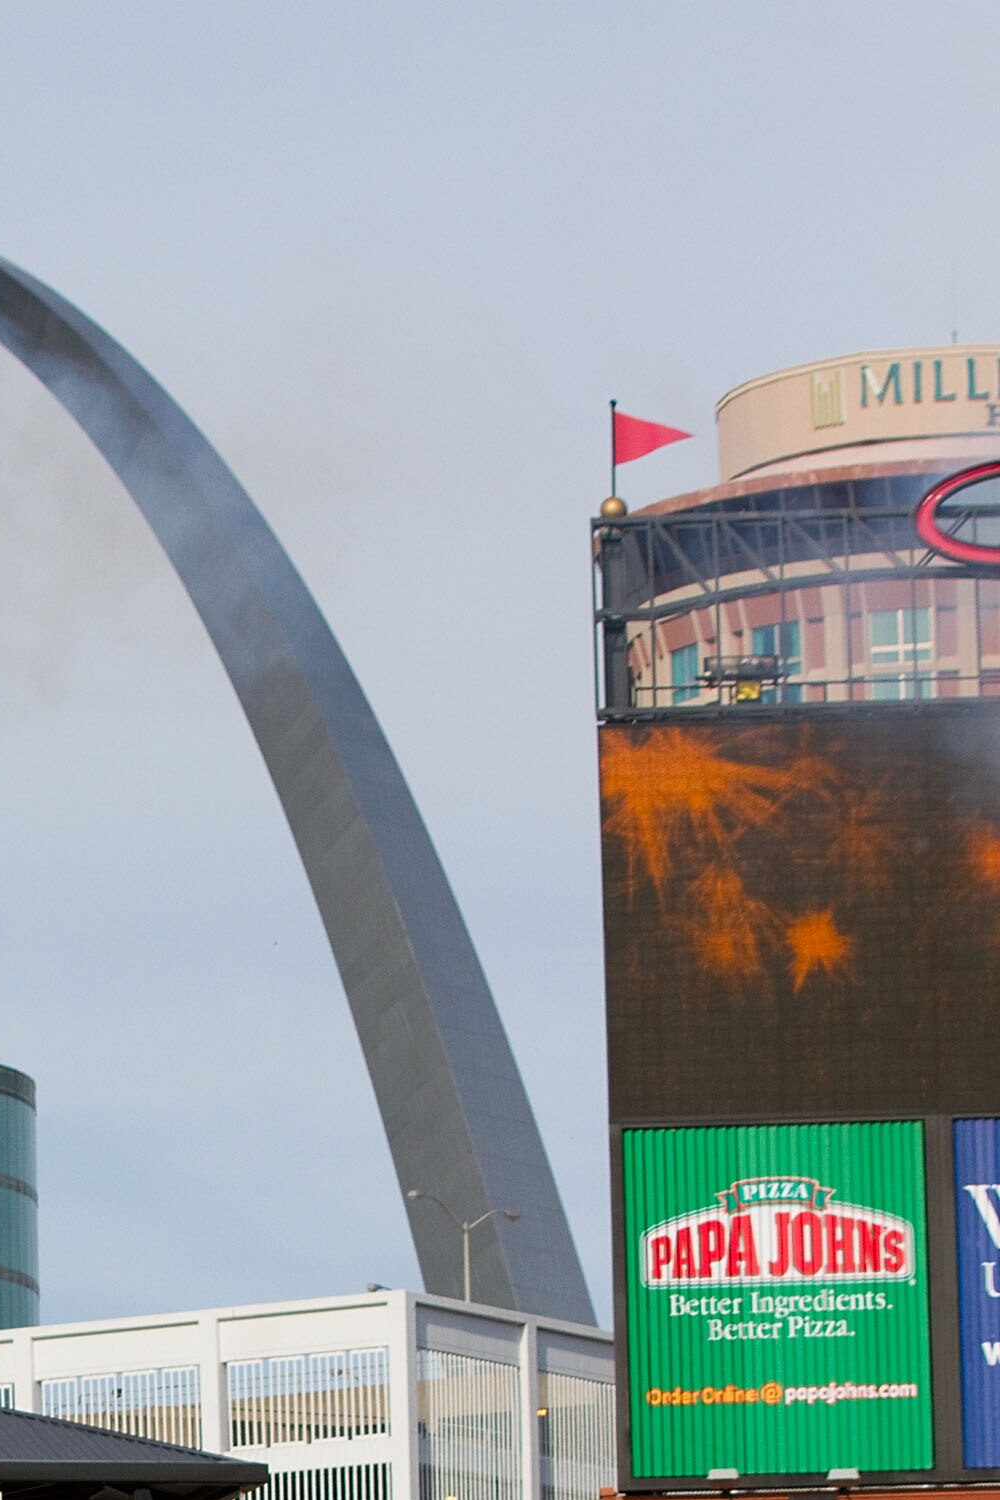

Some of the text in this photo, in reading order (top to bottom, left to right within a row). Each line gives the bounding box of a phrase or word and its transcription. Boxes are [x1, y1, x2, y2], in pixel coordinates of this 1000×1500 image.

[861, 356, 1000, 408] MILL
[742, 1182, 809, 1201] PIZZA
[651, 1214, 761, 1279] PAPA
[669, 1289, 893, 1319] Better Ingredients.
[707, 1315, 855, 1341] Better Pizza.
[647, 1381, 918, 1406] Order Online @ papajohns.com
